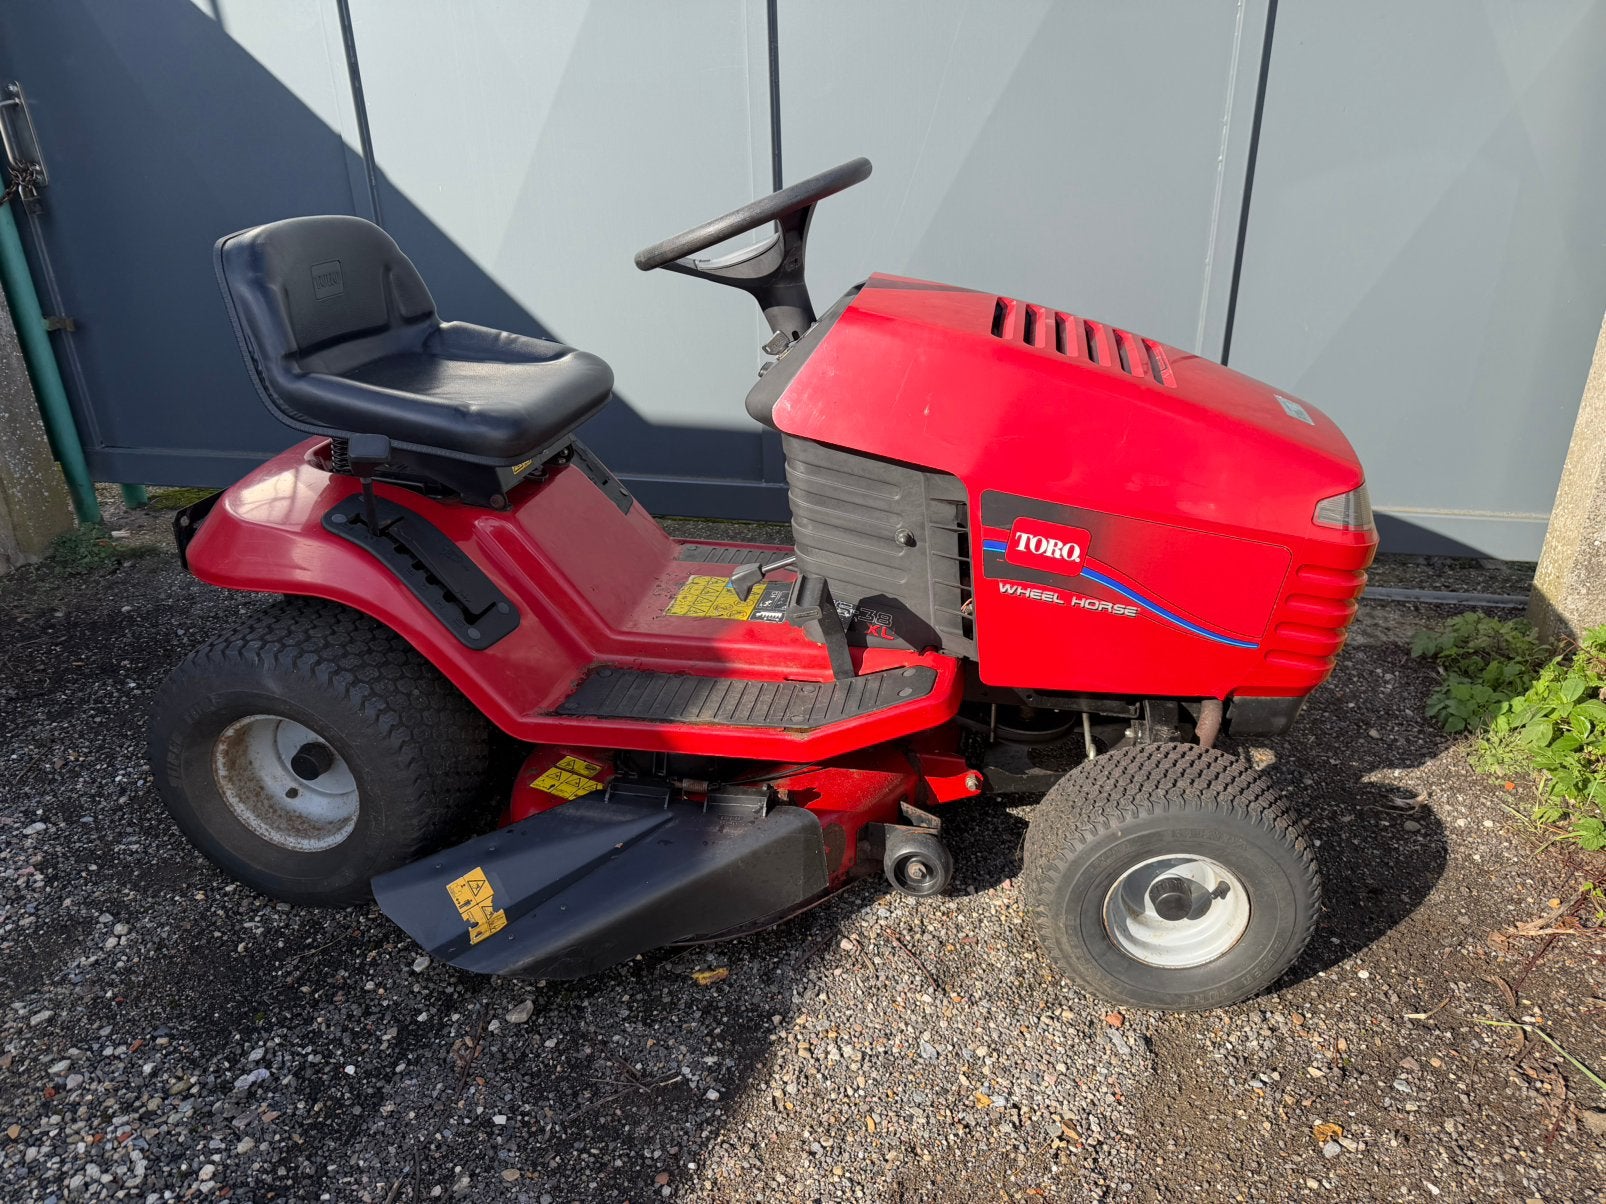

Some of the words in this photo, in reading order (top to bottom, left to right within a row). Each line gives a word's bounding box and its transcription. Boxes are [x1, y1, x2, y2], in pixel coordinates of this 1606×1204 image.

[1015, 532, 1080, 562] TORO
[999, 582, 1065, 605] WHEEL
[1071, 596, 1139, 617] HORSE
[865, 624, 895, 641] XL
